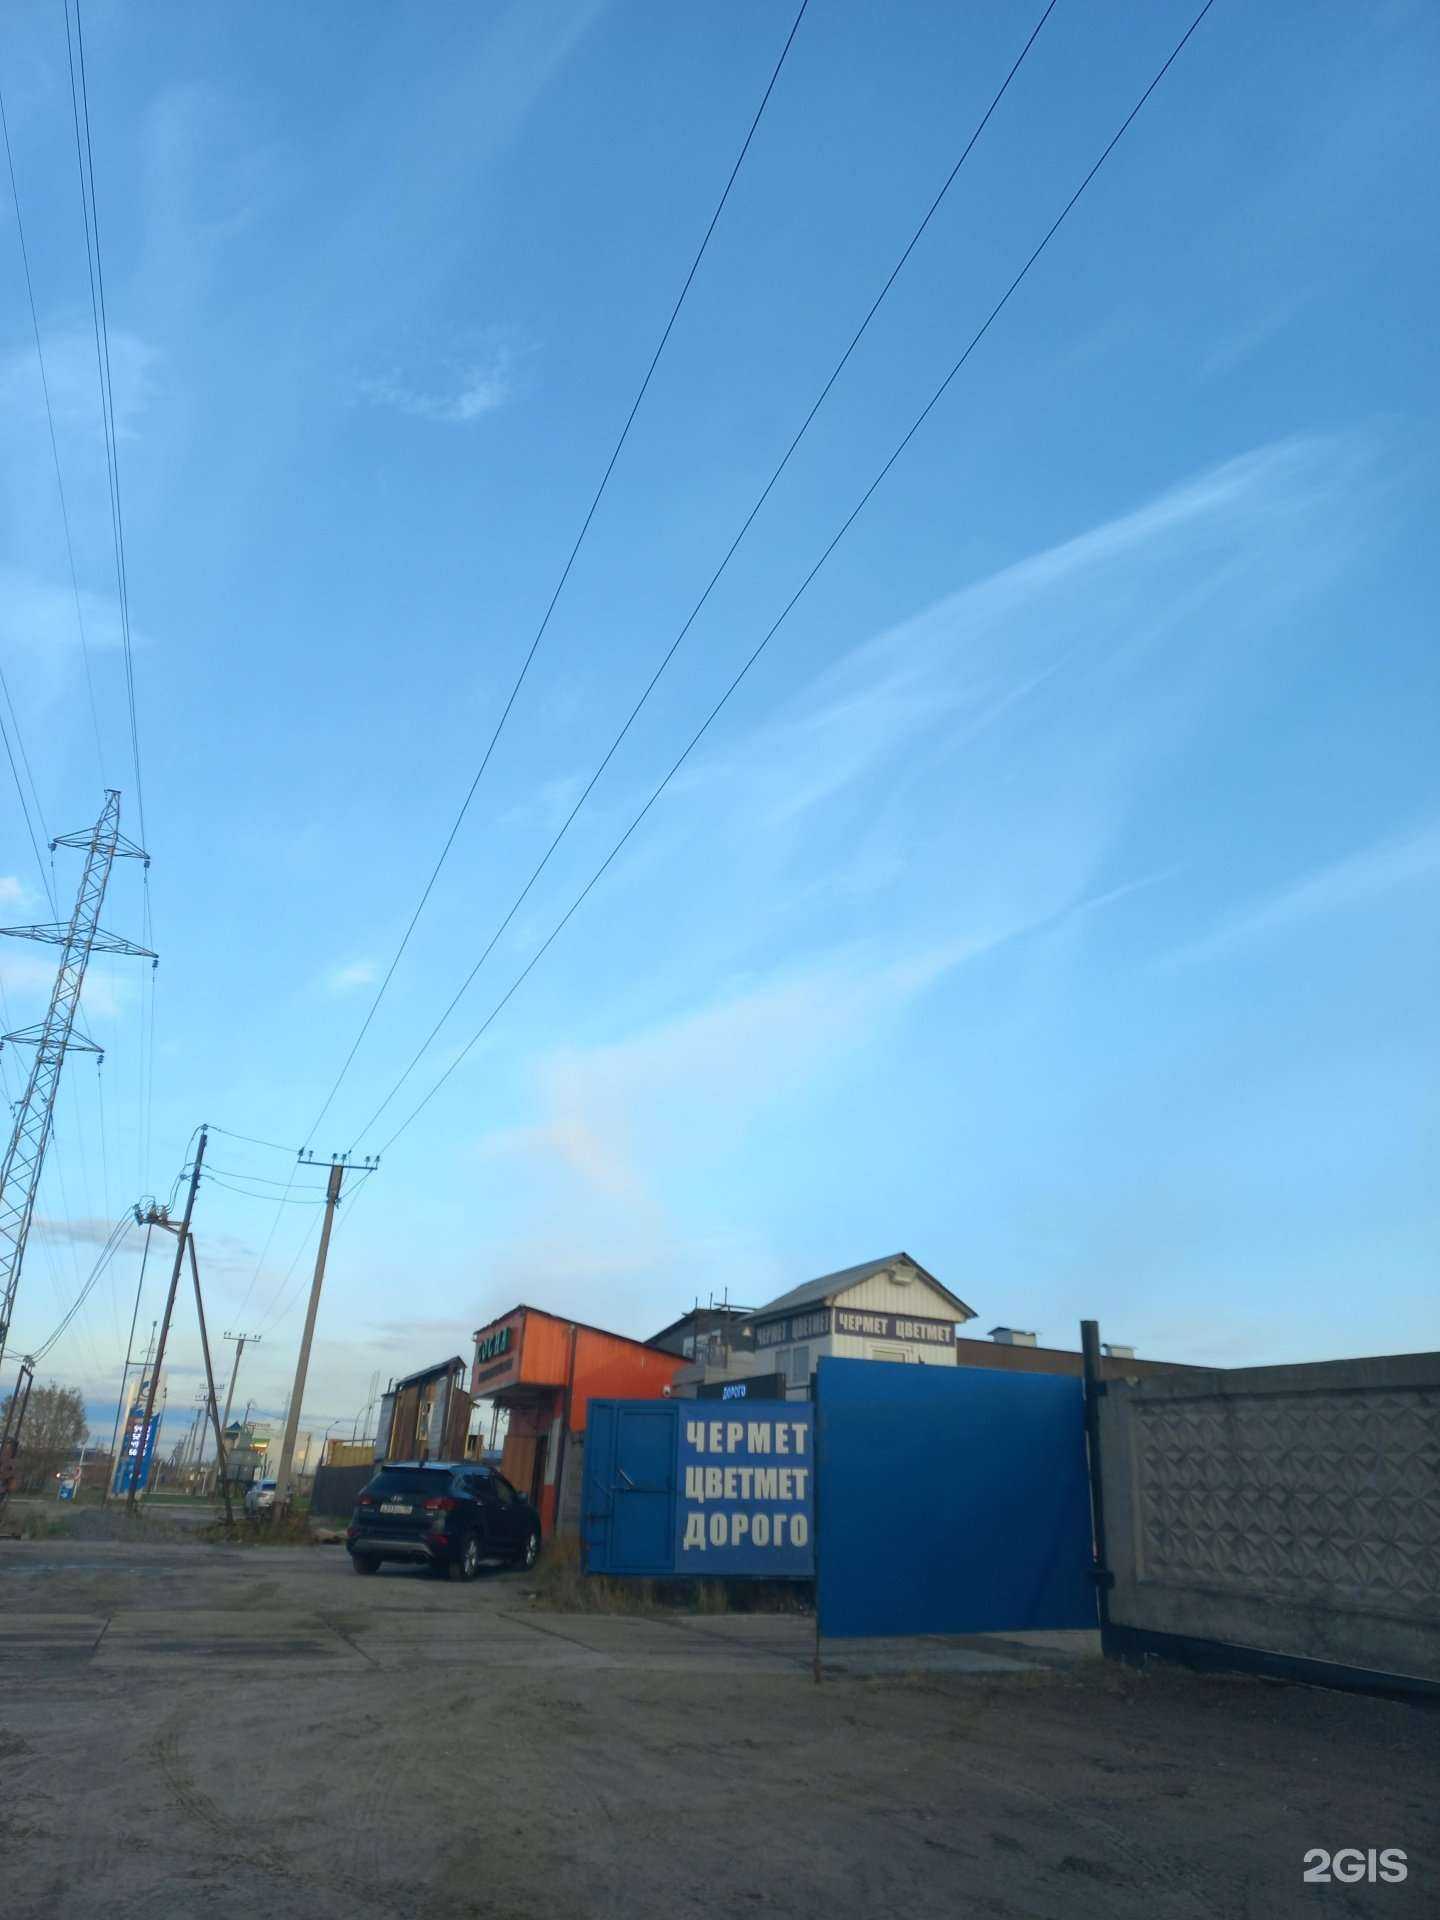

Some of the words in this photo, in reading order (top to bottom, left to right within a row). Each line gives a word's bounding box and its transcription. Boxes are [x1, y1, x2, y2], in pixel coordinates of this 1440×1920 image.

[840, 1312, 888, 1335] ЧЕРМЕТ
[895, 1319, 952, 1342] ЦВЕТМЕТ
[686, 1421, 808, 1454] ЧЕРМЕТ
[685, 1466, 809, 1504] ЦВЕТМЕТ
[683, 1512, 808, 1551] ДОРОГО
